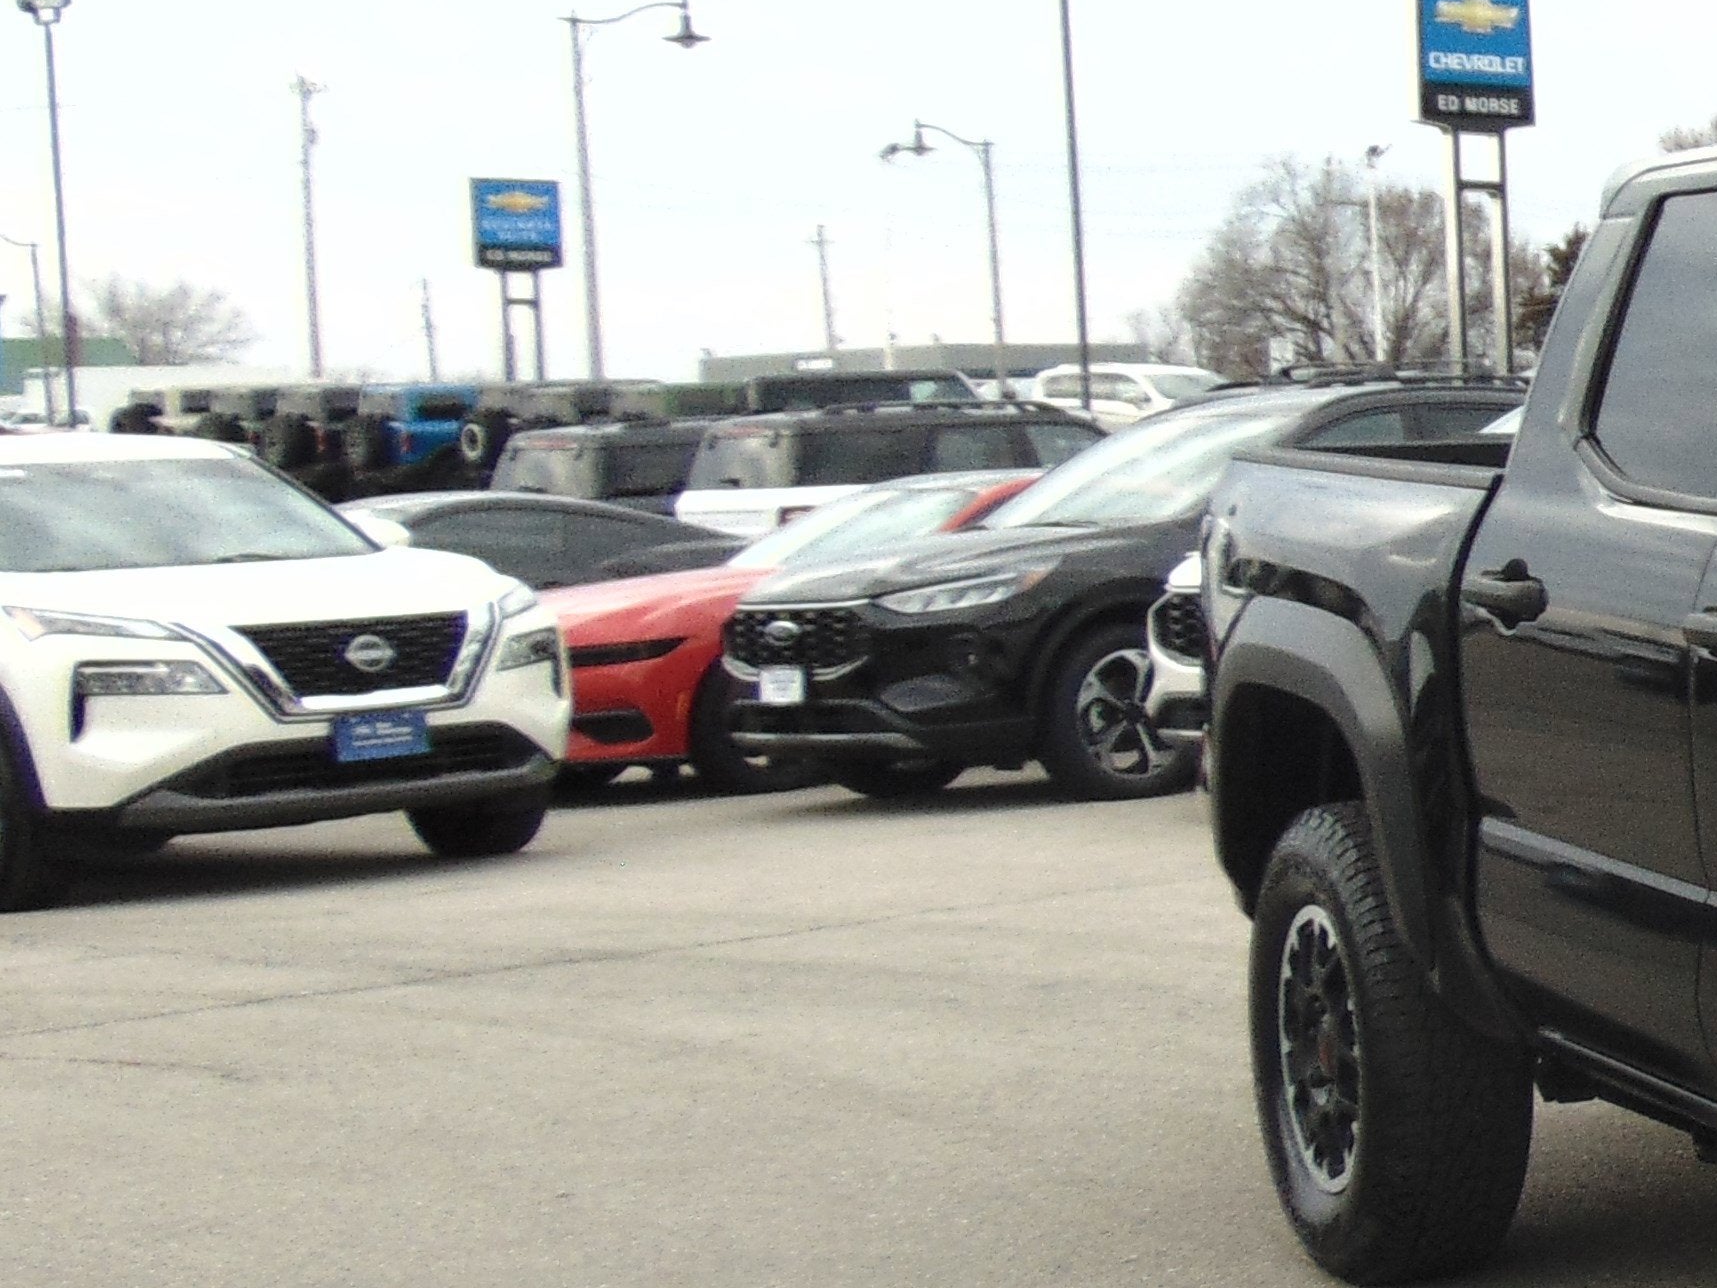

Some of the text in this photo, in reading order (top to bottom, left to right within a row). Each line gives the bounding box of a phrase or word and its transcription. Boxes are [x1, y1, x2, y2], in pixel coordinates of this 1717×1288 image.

[1429, 51, 1524, 73] CHEVROLET
[1437, 94, 1519, 114] ED MORSE
